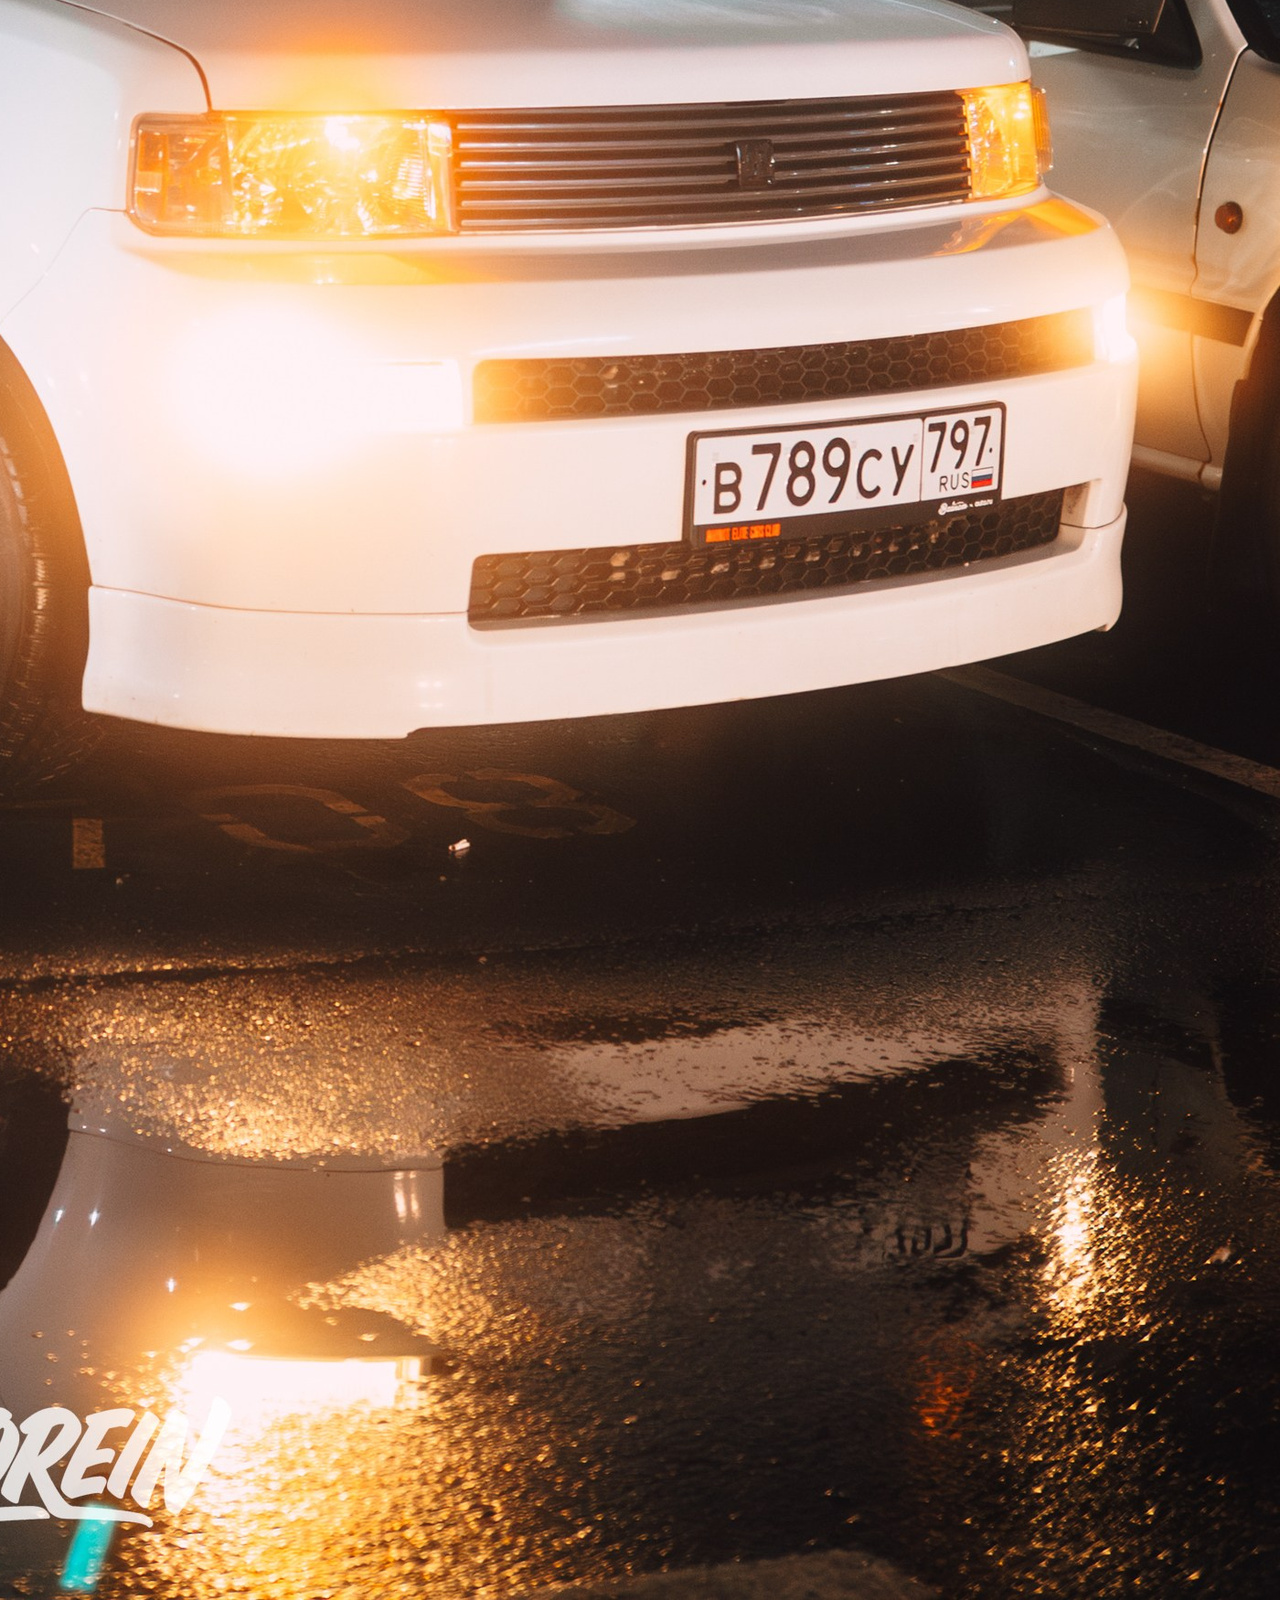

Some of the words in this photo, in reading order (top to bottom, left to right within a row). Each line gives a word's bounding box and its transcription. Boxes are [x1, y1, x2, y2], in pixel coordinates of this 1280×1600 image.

[713, 437, 915, 515] В789СУ
[928, 415, 992, 474] 797
[939, 471, 970, 493] RUS
